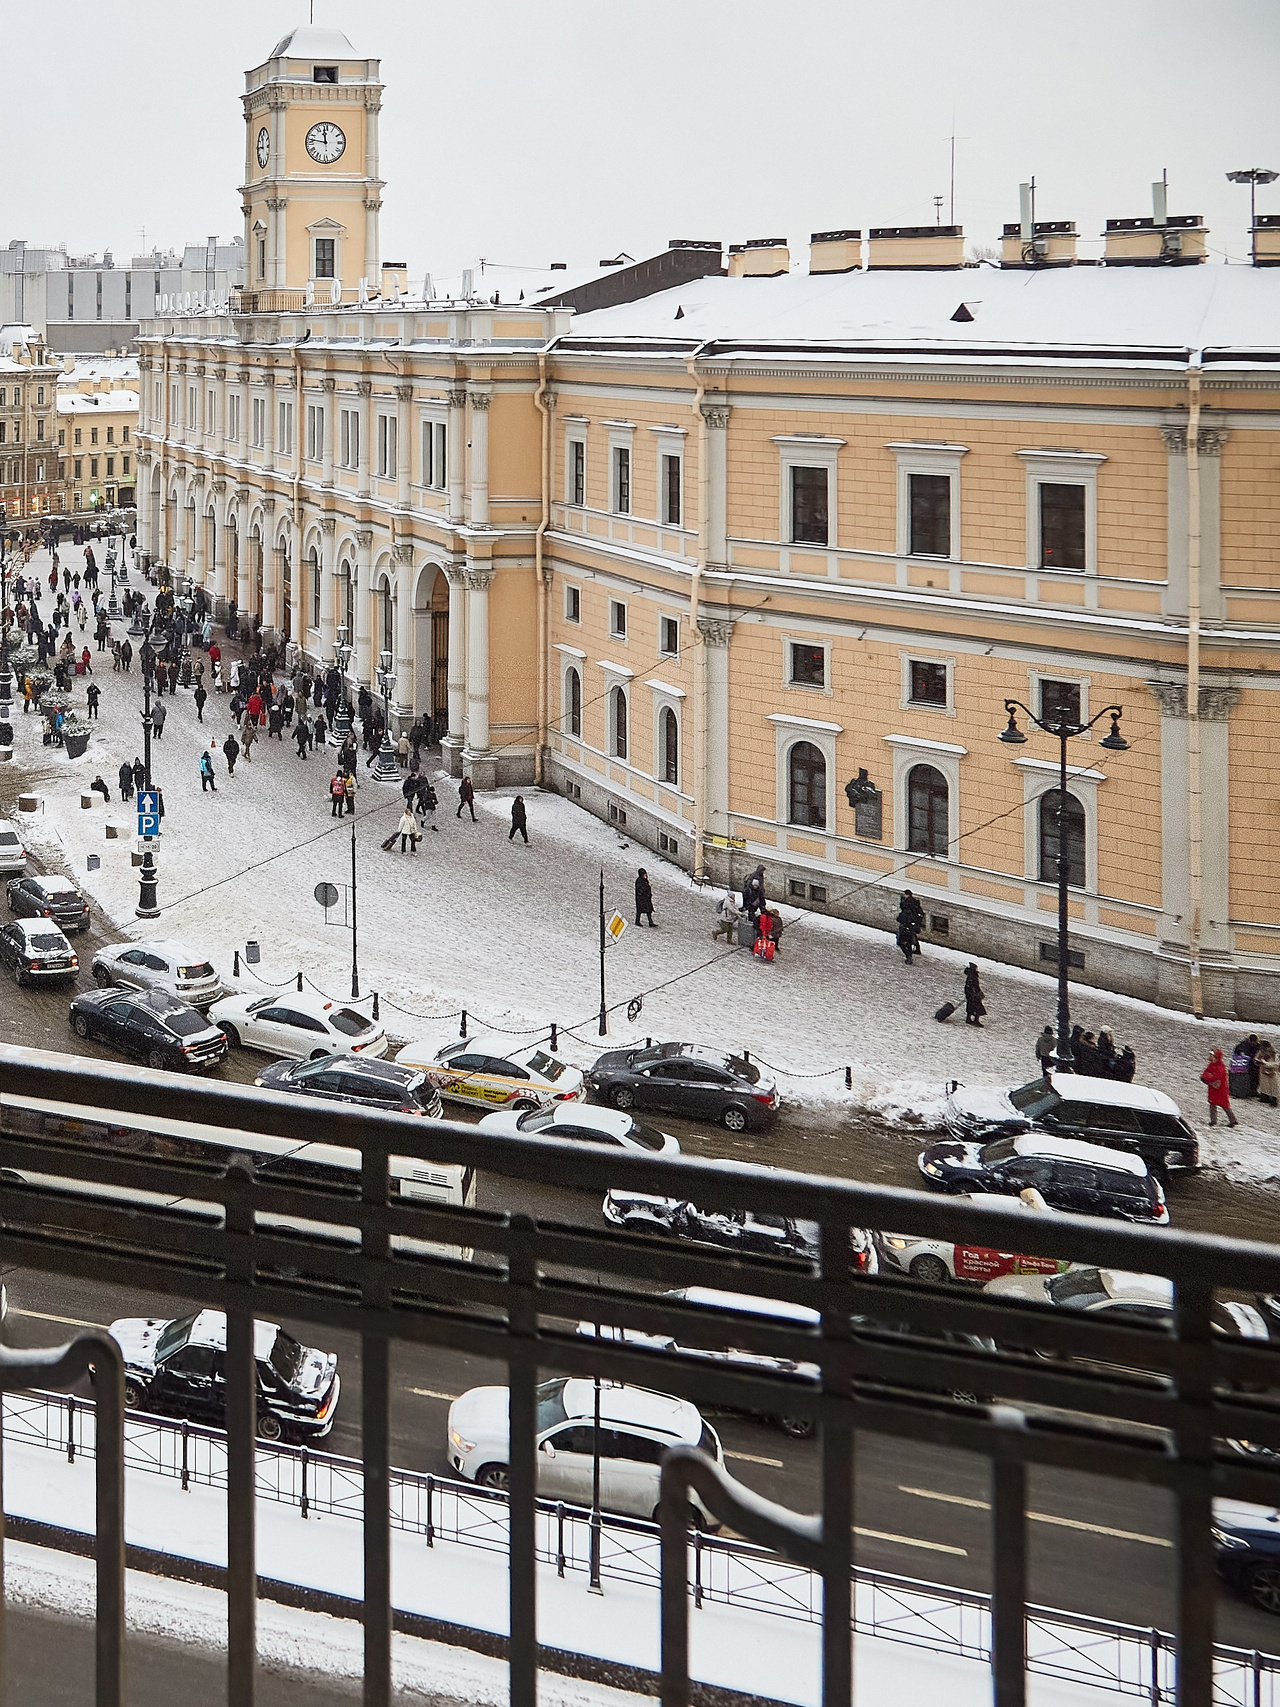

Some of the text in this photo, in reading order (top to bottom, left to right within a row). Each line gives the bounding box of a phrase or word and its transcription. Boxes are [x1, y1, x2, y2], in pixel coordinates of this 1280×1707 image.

[142, 816, 155, 834] P
[962, 1250, 980, 1260] Год
[963, 1259, 1000, 1268] красной
[963, 1264, 991, 1273] карты
